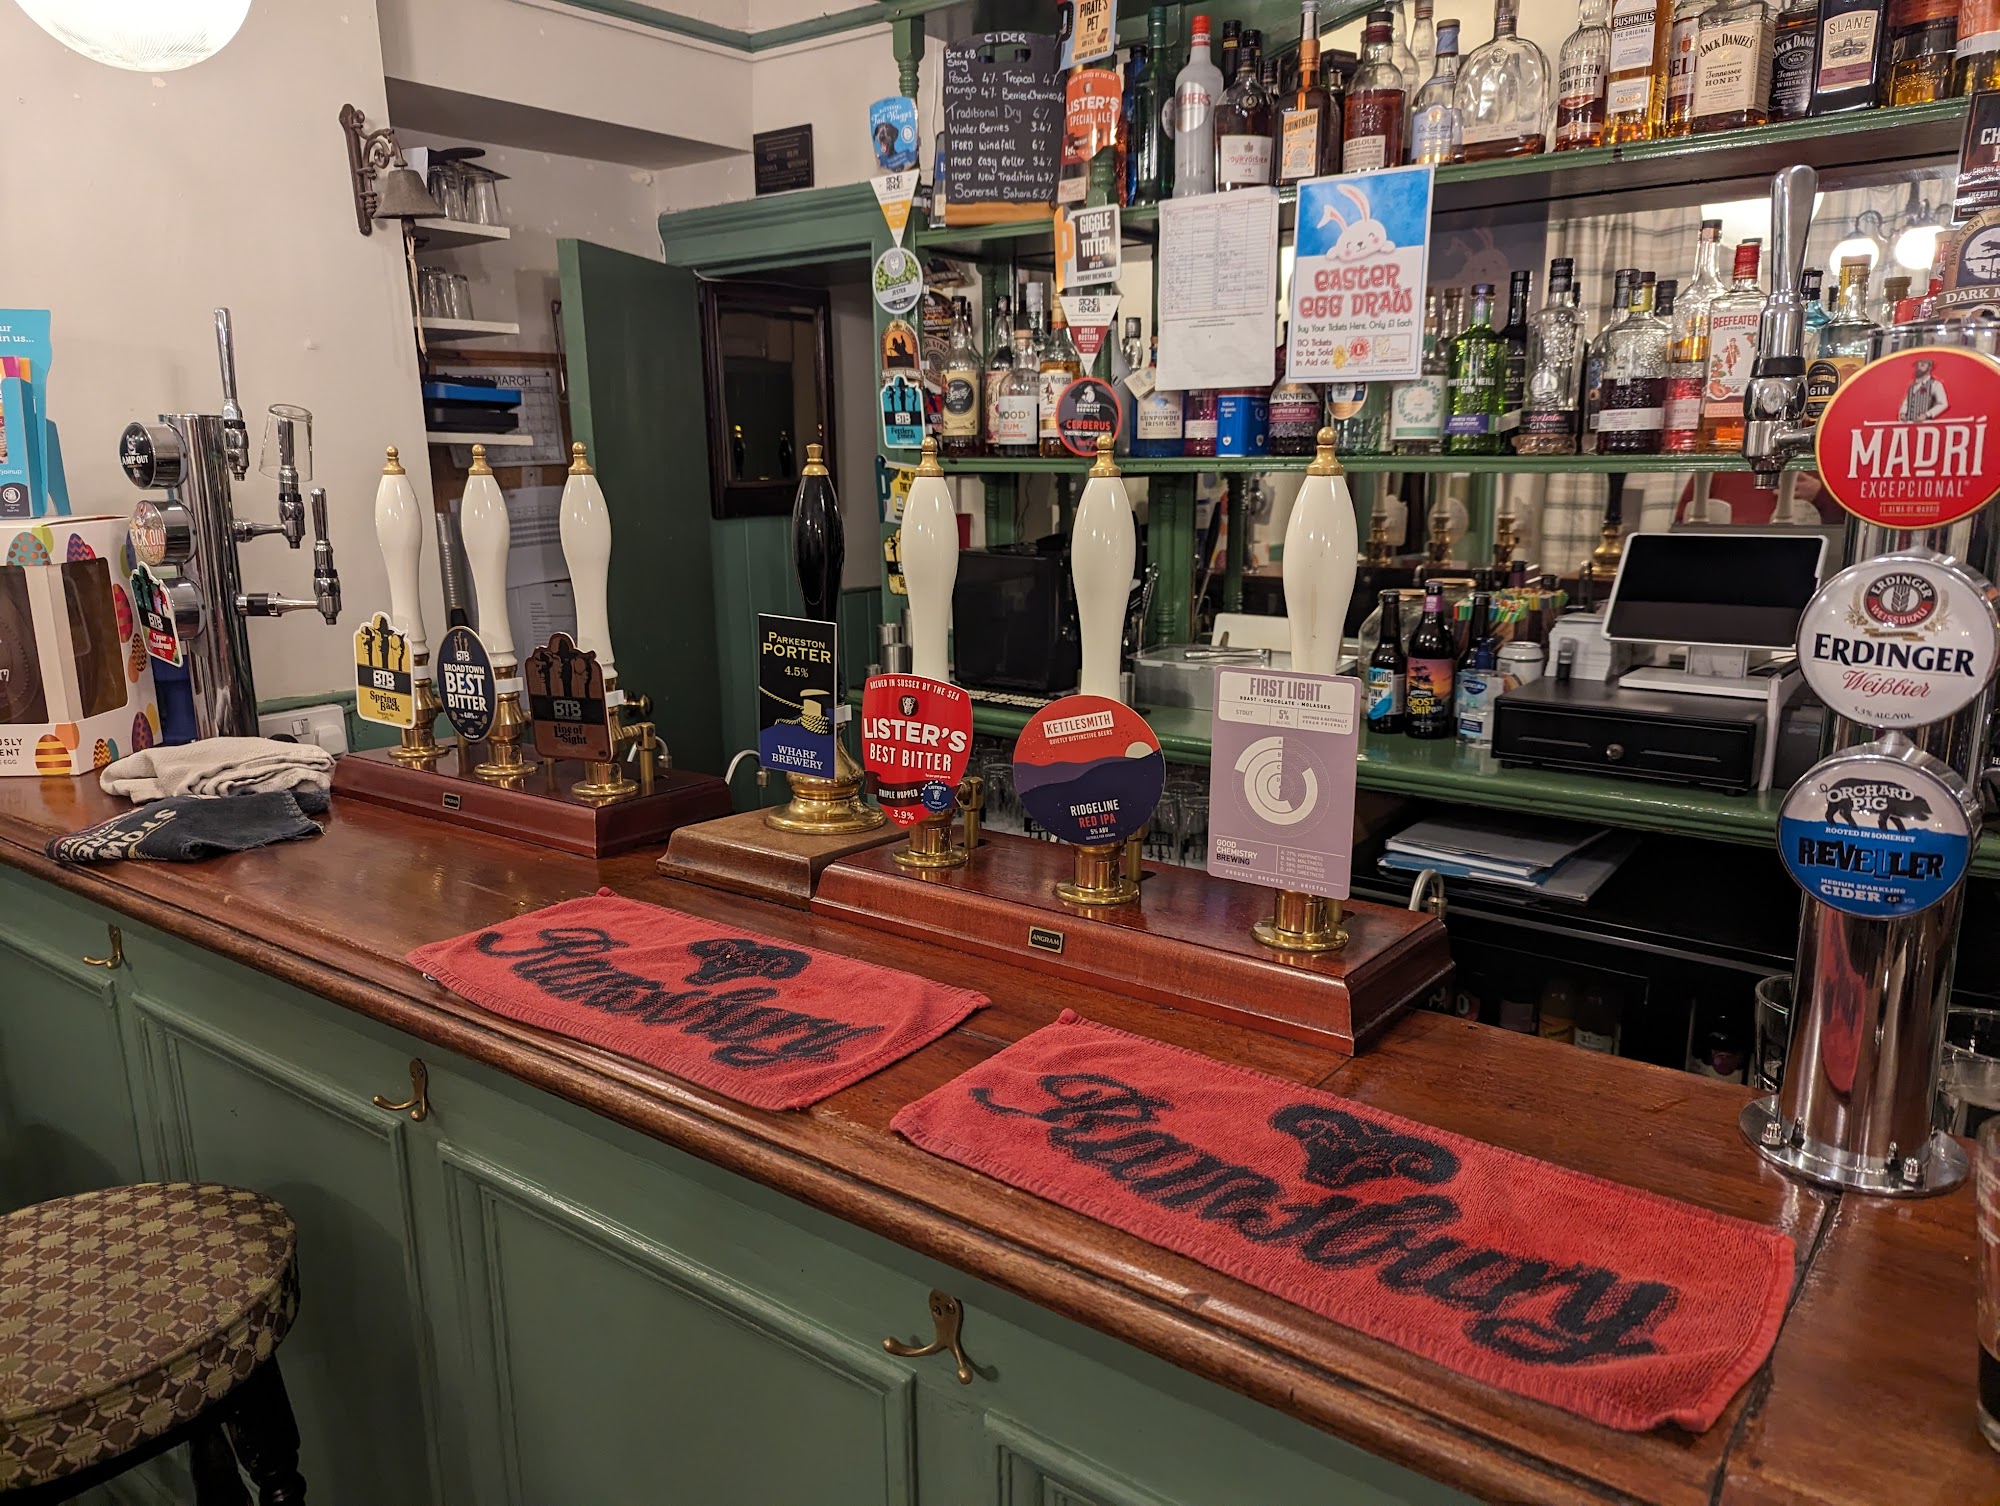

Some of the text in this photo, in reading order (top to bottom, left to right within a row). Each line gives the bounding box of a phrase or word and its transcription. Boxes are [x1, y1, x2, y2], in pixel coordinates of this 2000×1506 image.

[1086, 15, 1099, 32] PET
[1614, 11, 1655, 27] BUSHMILLS
[1829, 16, 1872, 35] SLANE
[984, 33, 1026, 44] CIDER
[1625, 28, 1651, 37] ORIGINAL
[1700, 33, 1756, 58] JACK DANIEL'S
[1773, 40, 1792, 59] JACK
[946, 49, 962, 59] Bee
[949, 70, 1035, 86] Peach Tropical
[1560, 64, 1601, 80] SOUTHERN
[1706, 68, 1742, 79] Tennessee
[1777, 69, 1812, 79] Tennessee
[1705, 75, 1741, 87] HONEY
[1777, 78, 1811, 88] WHISKEY
[945, 101, 1021, 123] Traditional Dry
[1066, 96, 1119, 116] LISTER'S
[1070, 111, 1111, 126] SPECIAL ALE
[1285, 114, 1316, 133] COINTREAU
[949, 122, 1009, 135] Winter Berries
[1001, 157, 1025, 168] Roller
[978, 170, 1034, 182] New Tradition
[955, 183, 998, 198] Somerset
[1080, 211, 1110, 234] GIGGLE
[1081, 236, 1111, 258] TITTER
[1351, 288, 1413, 317] DRAW
[1946, 288, 1989, 304] DARK
[1311, 324, 1325, 332] Your
[1328, 322, 1347, 331] Tickets
[1369, 320, 1385, 330] Only
[1397, 319, 1412, 327] Each
[1713, 314, 1758, 330] BEEFEATER
[1078, 334, 1099, 342] BUSTARD
[1311, 338, 1332, 346] Tickets
[1317, 348, 1333, 356] Sold
[496, 375, 531, 387] MARCH
[1050, 375, 1072, 385] Morgan
[1616, 378, 1631, 386] GIN
[1272, 392, 1312, 401] WARNER'S
[1461, 386, 1475, 394] GIN
[1809, 387, 1829, 395] GIN
[1066, 420, 1111, 431] CERBERUS
[1529, 422, 1546, 430] GIN
[1847, 415, 1987, 479] MADRÍ
[136, 454, 148, 464] OUT
[1860, 480, 1965, 499] EXCEPCIONAL
[149, 528, 165, 545] OIL
[1871, 575, 1933, 599] ERDINGER
[768, 631, 826, 650] PARKESTON
[456, 650, 470, 661] BTB
[763, 643, 831, 664] PORTER
[1812, 633, 1976, 677] ERDINGER
[443, 663, 485, 675] BROADTOWN
[784, 665, 809, 678] 4.5%
[373, 669, 395, 688] BTB
[444, 671, 485, 696] BEST
[1842, 669, 1932, 699] Weißbier
[889, 679, 960, 701] IN SUSSEX BY THE SEA
[1249, 677, 1322, 702] FIRST LIGHT
[370, 690, 398, 704] Spring
[447, 692, 488, 712] BITTER
[1263, 698, 1295, 706] CHOCOLATE
[1301, 702, 1331, 710] MOLASSES
[1407, 697, 1434, 707] GHOST
[380, 701, 401, 712] Back
[553, 700, 581, 717] BTB
[1411, 705, 1431, 715] SHIP
[1854, 706, 1872, 717] 5.3%
[1278, 709, 1289, 720] 5%
[553, 723, 583, 737] Line of
[1046, 714, 1112, 735] KETTLESMITH
[1321, 721, 1347, 729] FRIENDLY
[562, 733, 587, 745] Sight
[863, 717, 968, 753] LISTER'S
[1049, 737, 1068, 745] QUIETLY
[1068, 732, 1097, 742] DISTINCTIVE
[777, 744, 817, 760] WHARF
[869, 742, 952, 772] BEST BITTER
[771, 752, 823, 771] BREWERY
[878, 788, 919, 799] TRIPLE HOPPED
[1826, 784, 1916, 803] ORCHARD
[1070, 799, 1120, 817] RIDGELINE
[1851, 797, 1889, 811] PIG
[893, 809, 915, 820] 3.9%
[1078, 812, 1117, 828] RED IPA
[1099, 826, 1109, 834] ABV
[1825, 827, 1916, 843] ROOTED IN SOMERSET
[1216, 839, 1236, 849] GOOD
[1216, 846, 1258, 860] CHEMISTRY
[1216, 853, 1250, 865] BREWING
[1798, 836, 1946, 881] REVELLER
[1297, 858, 1323, 867] MALTINESS
[1297, 864, 1324, 873] BITTERNESS
[1225, 869, 1253, 879] PROUDLY
[1258, 875, 1283, 885] BREWED
[1300, 883, 1328, 893] BRISTOL
[1297, 869, 1324, 879] SWEETNESS
[1820, 884, 1881, 902] CIDER
[1821, 878, 1906, 894] MEDIUM SPARKLING
[1032, 934, 1059, 946] ANGRAM
[967, 1071, 1682, 1365] Ramsbury
